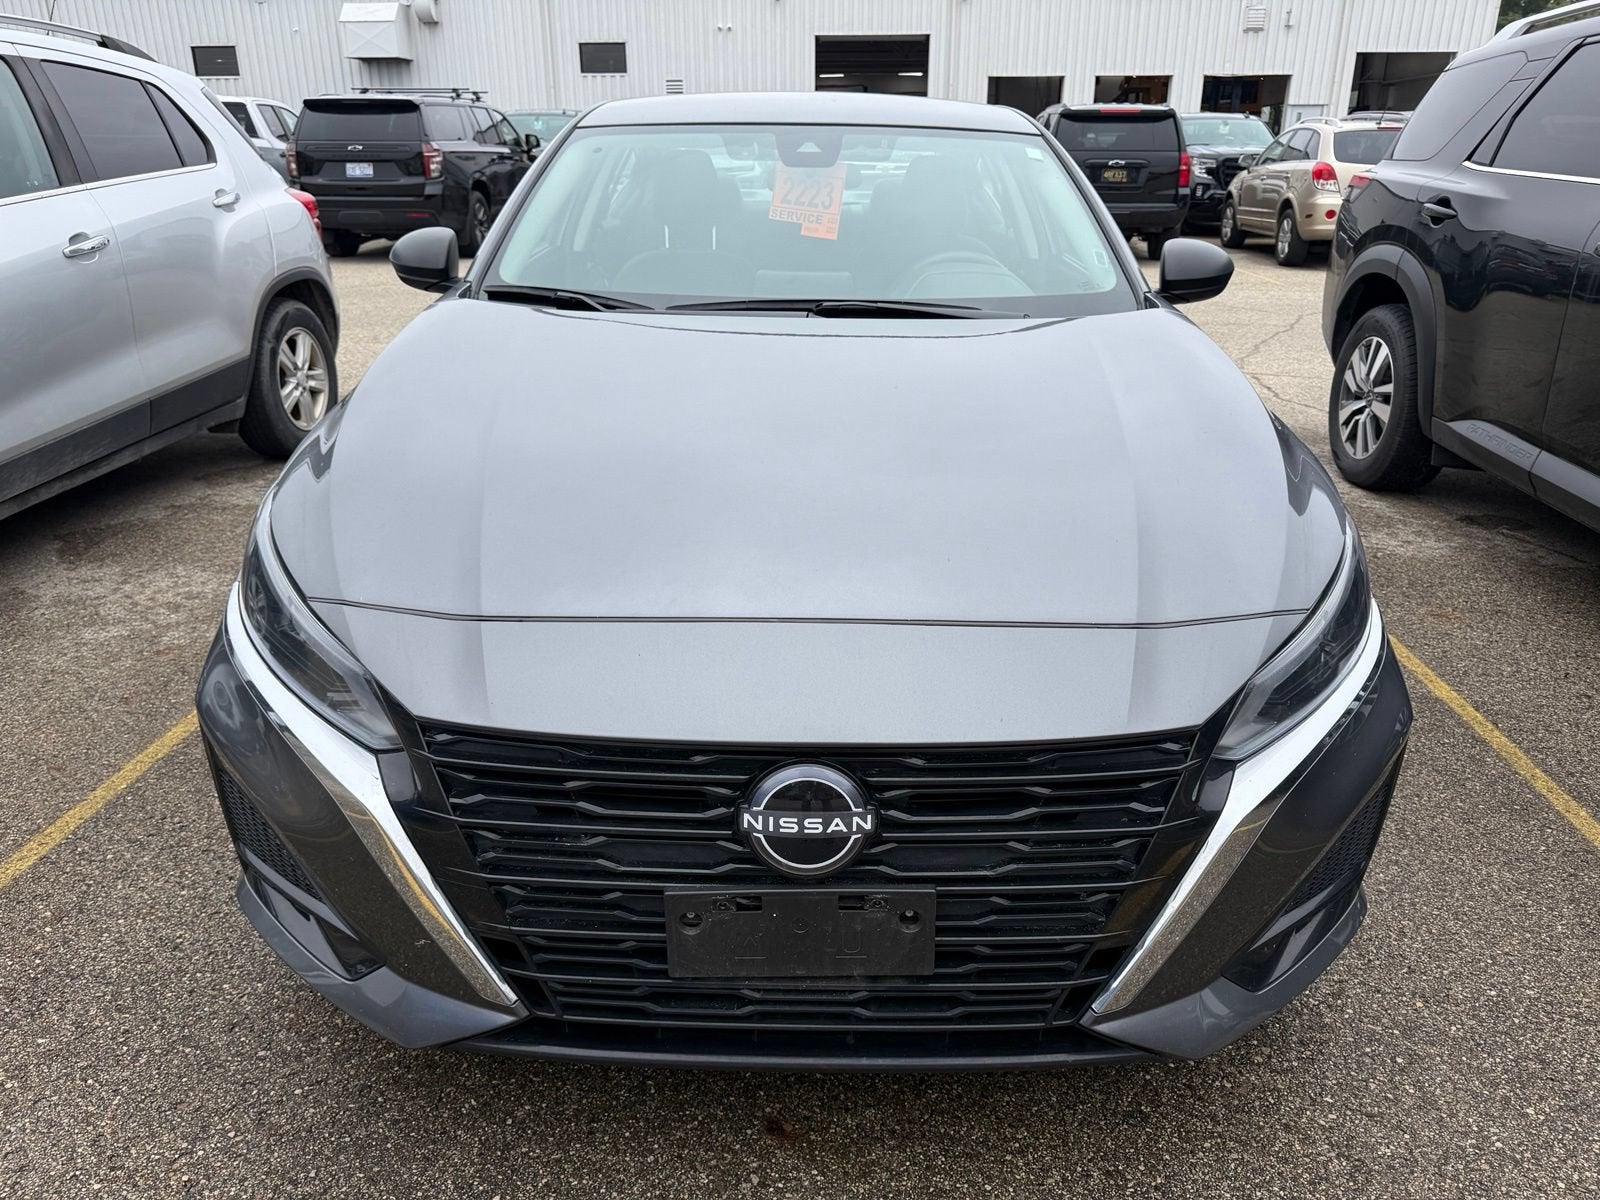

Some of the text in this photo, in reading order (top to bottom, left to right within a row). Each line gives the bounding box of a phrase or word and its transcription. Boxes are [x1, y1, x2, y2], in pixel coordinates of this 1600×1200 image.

[781, 178, 834, 209] 2223
[770, 208, 823, 225] SERVICE
[743, 813, 872, 834] NISSAN
